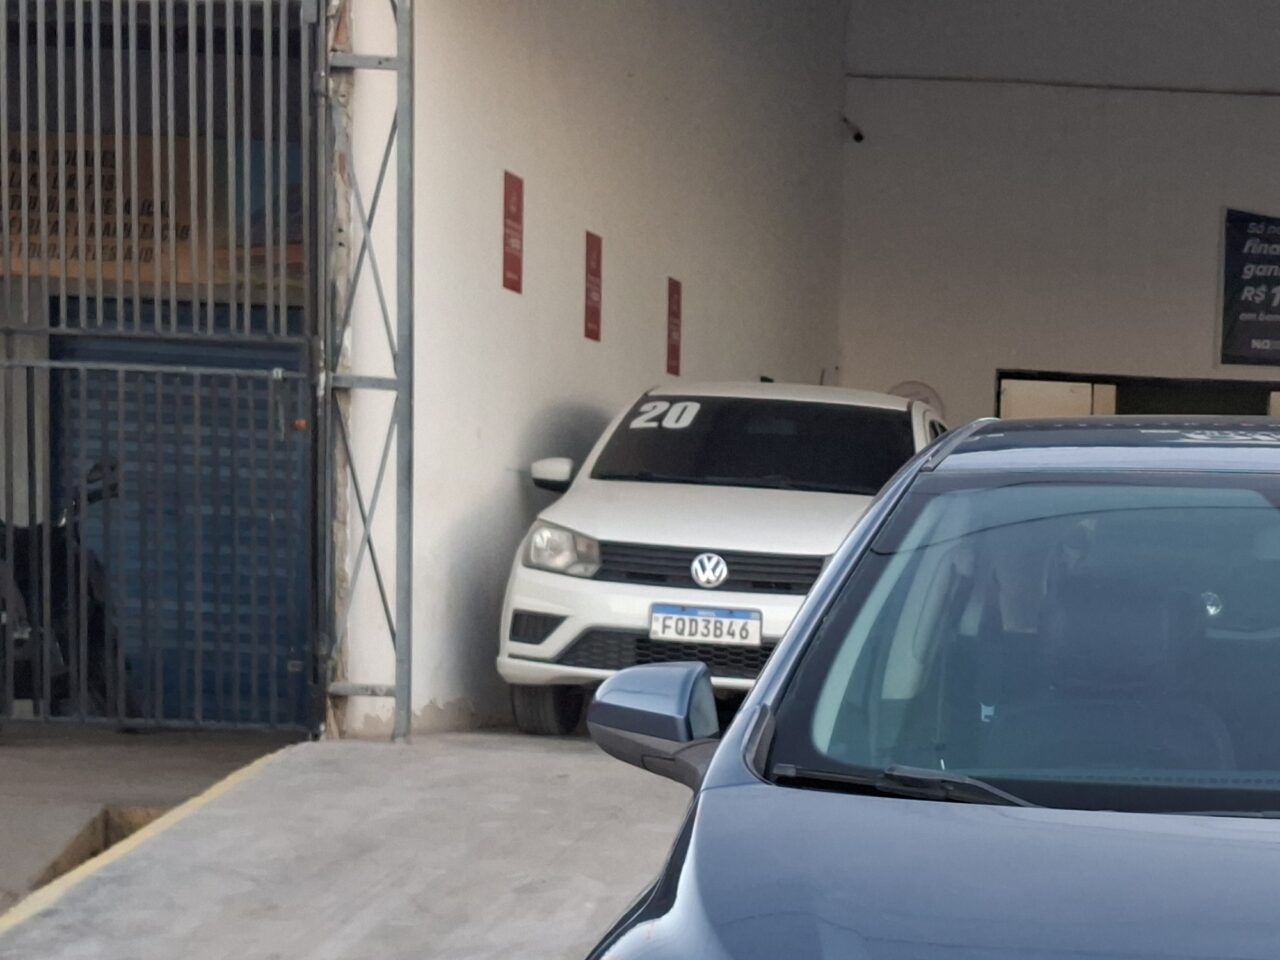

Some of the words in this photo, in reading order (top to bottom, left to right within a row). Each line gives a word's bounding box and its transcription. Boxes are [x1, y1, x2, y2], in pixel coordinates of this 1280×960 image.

[1241, 283, 1267, 304] R$
[629, 400, 701, 430] 20
[661, 616, 750, 640] FQD3B46
